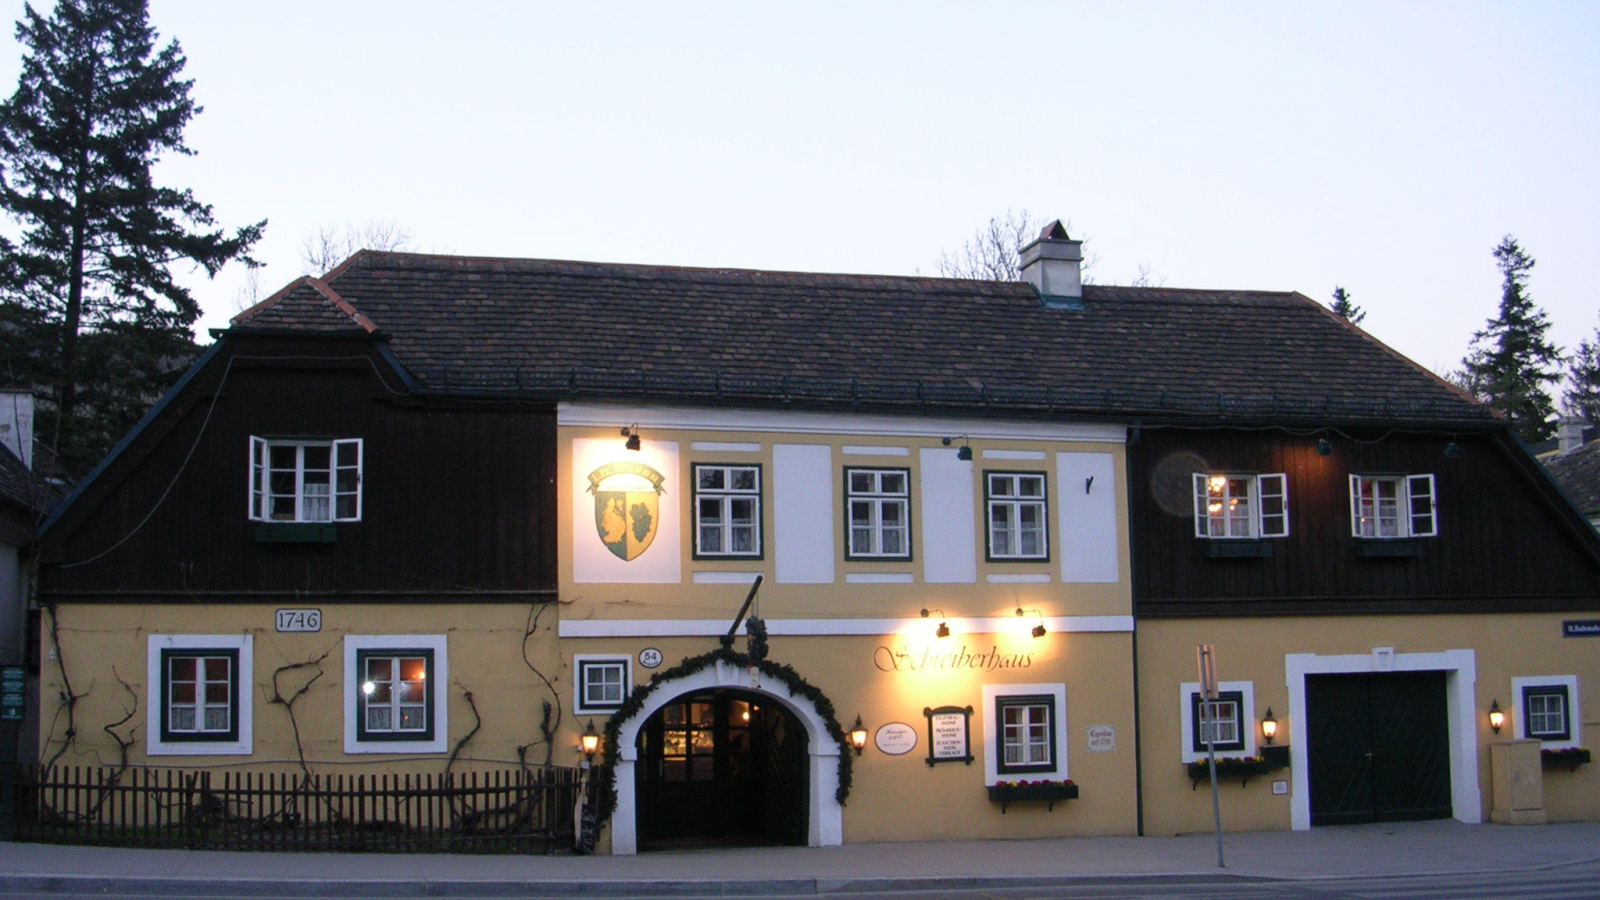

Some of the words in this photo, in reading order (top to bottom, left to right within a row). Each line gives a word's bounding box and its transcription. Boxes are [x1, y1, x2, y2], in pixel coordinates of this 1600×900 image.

[280, 612, 318, 628] 1746
[645, 651, 656, 660] 54
[874, 645, 1034, 673] Schreiberhaus
